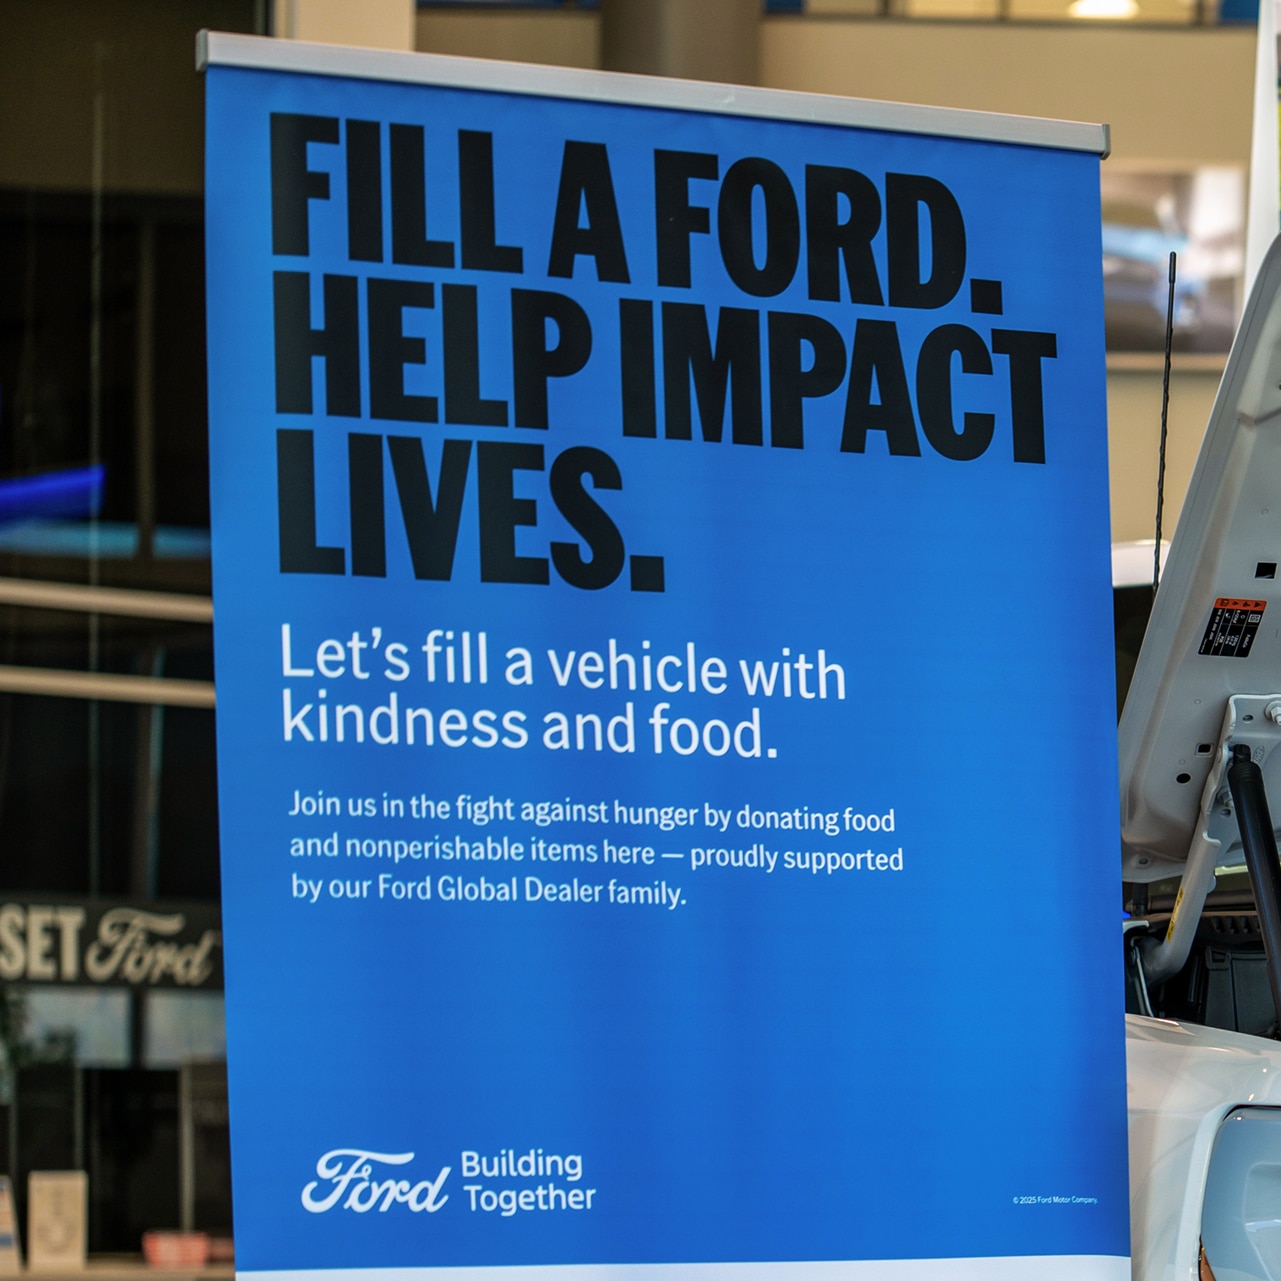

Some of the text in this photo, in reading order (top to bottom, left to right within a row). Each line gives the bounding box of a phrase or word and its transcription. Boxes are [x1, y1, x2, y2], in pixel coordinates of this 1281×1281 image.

[270, 112, 1004, 315] FILL A FORD.
[272, 270, 1058, 465] HELP IMPACT
[276, 428, 666, 593] LIVES.
[282, 623, 846, 700] Let’s fill a vehicle with
[282, 688, 777, 758] kindness and food.
[288, 790, 895, 836] Join us in the fight against hunger by donating food
[290, 832, 903, 875] and nonperishable items here proudly supported
[292, 872, 687, 910] by our Ford Global Dealer family.
[0, 906, 214, 984] SET Ford
[301, 1148, 582, 1213] Ford Building
[464, 1183, 597, 1217] Together
[1019, 1196, 1036, 1204] 2025
[1037, 1196, 1052, 1204] Ford
